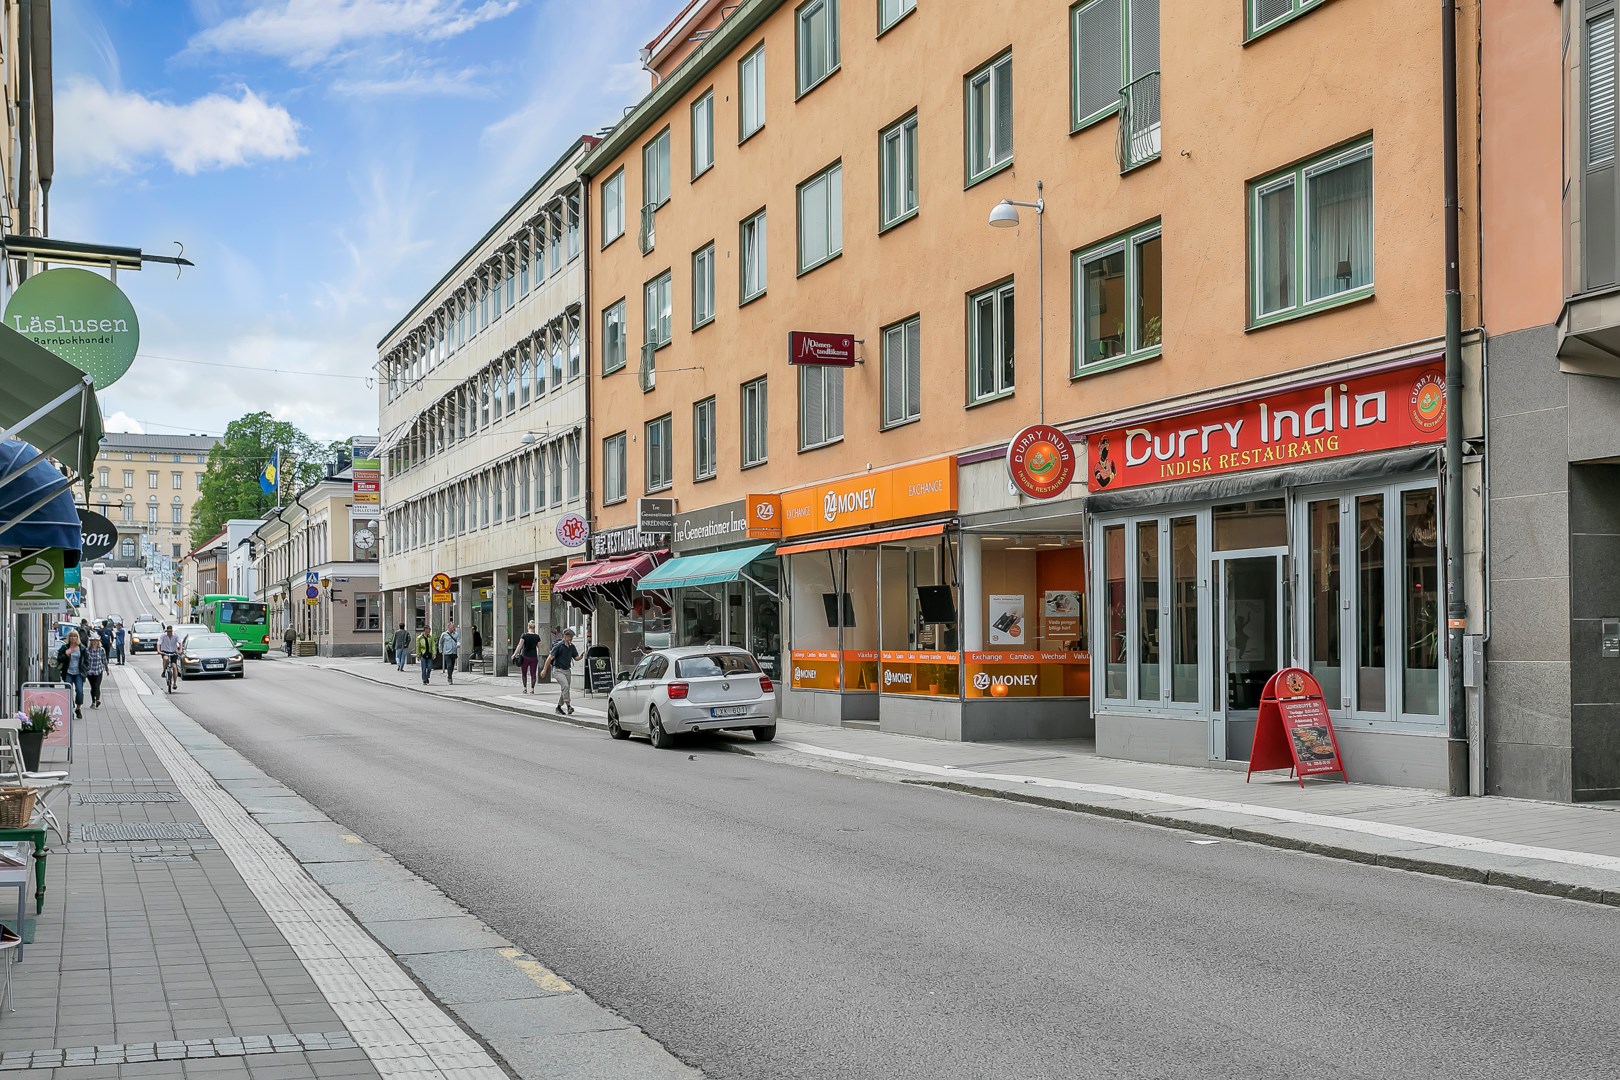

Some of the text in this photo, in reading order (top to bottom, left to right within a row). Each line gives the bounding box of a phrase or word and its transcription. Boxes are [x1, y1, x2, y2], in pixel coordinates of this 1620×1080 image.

[14, 315, 128, 333] Läslusen
[34, 335, 114, 346] Barnbokhandel
[1125, 384, 1388, 468] Curry India
[1014, 430, 1069, 463] CURRY INDIA
[1160, 435, 1340, 478] INDISK RESTAURANG
[908, 480, 942, 497] EXCHANGE
[1018, 468, 1068, 493] INDISK RESTAURANG
[756, 502, 774, 520] 24
[786, 506, 811, 520] EXCHANGE
[824, 488, 876, 522] 24 MONEY
[673, 522, 684, 542] Tre
[684, 520, 730, 540] Generationer
[800, 670, 816, 679] MONEY
[892, 673, 912, 684] MONEY
[973, 672, 1038, 690] 24 MONEY
